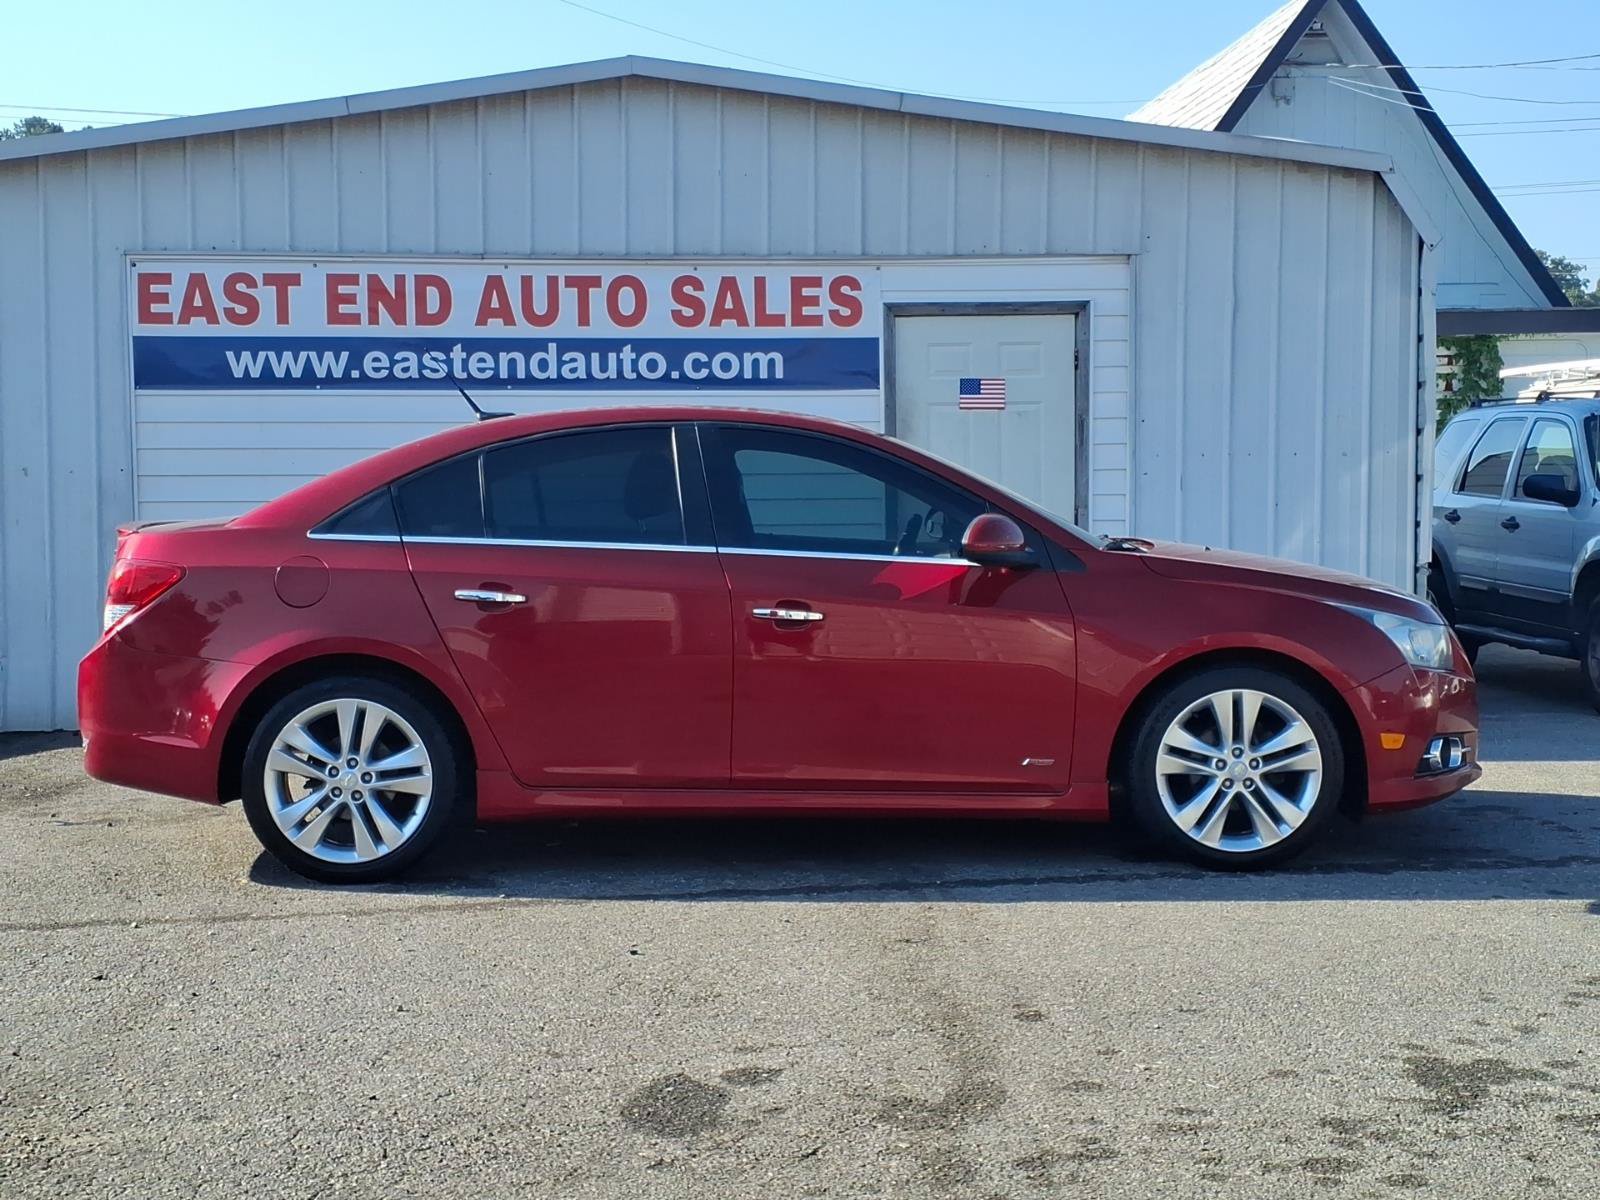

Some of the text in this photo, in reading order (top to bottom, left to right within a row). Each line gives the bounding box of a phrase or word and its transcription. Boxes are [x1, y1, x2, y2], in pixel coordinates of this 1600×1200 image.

[137, 273, 864, 329] EAST END AUTO SALES
[225, 342, 785, 381] www.eastendauto.com
